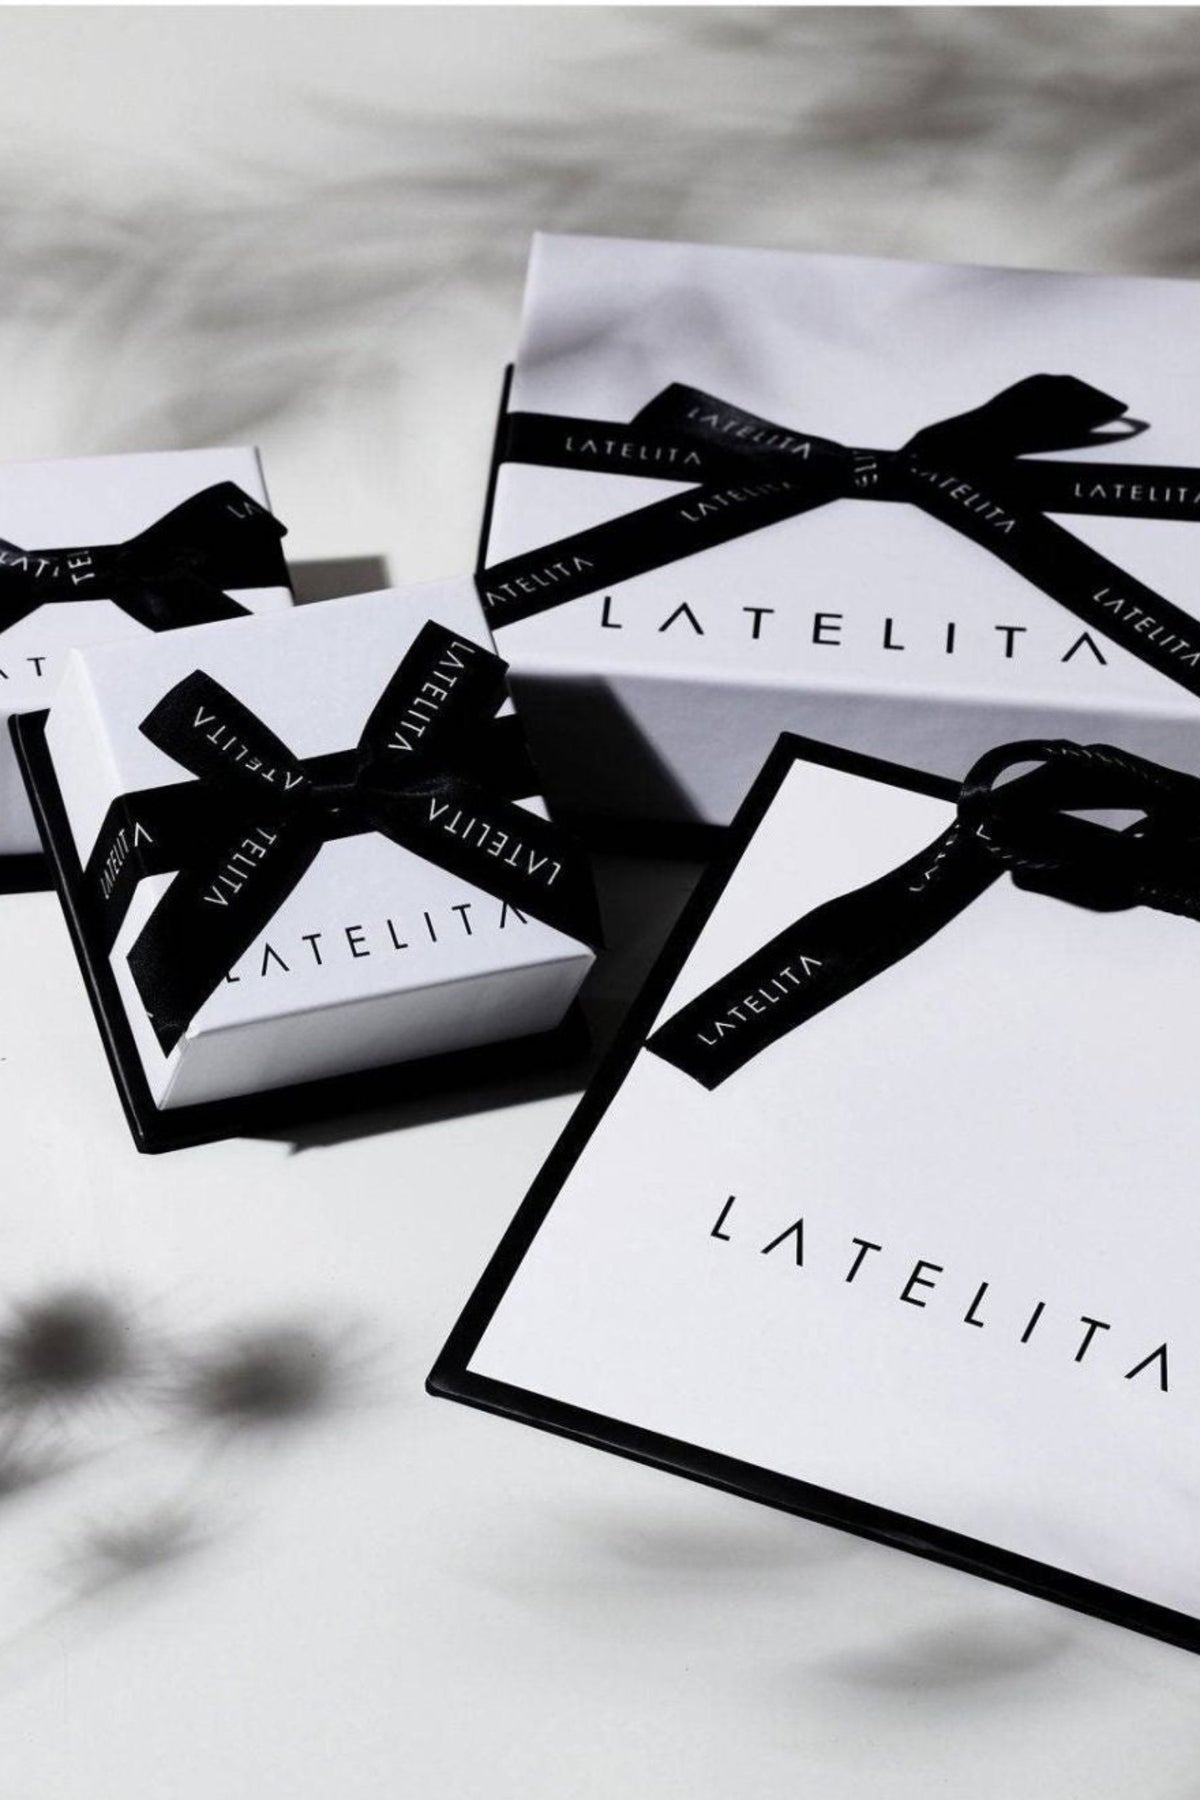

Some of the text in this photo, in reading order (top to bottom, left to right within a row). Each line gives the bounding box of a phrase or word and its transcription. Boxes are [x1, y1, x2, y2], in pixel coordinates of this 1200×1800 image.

[564, 435, 703, 466] LATELITA
[687, 406, 813, 461] LATELITA
[600, 595, 1109, 666] LATELITA
[387, 641, 476, 753] LATELITA
[192, 705, 312, 792] ATELITA
[427, 797, 562, 886] LATELITA
[697, 954, 823, 1048] LATELITA
[710, 1194, 1169, 1393] LATELITA
